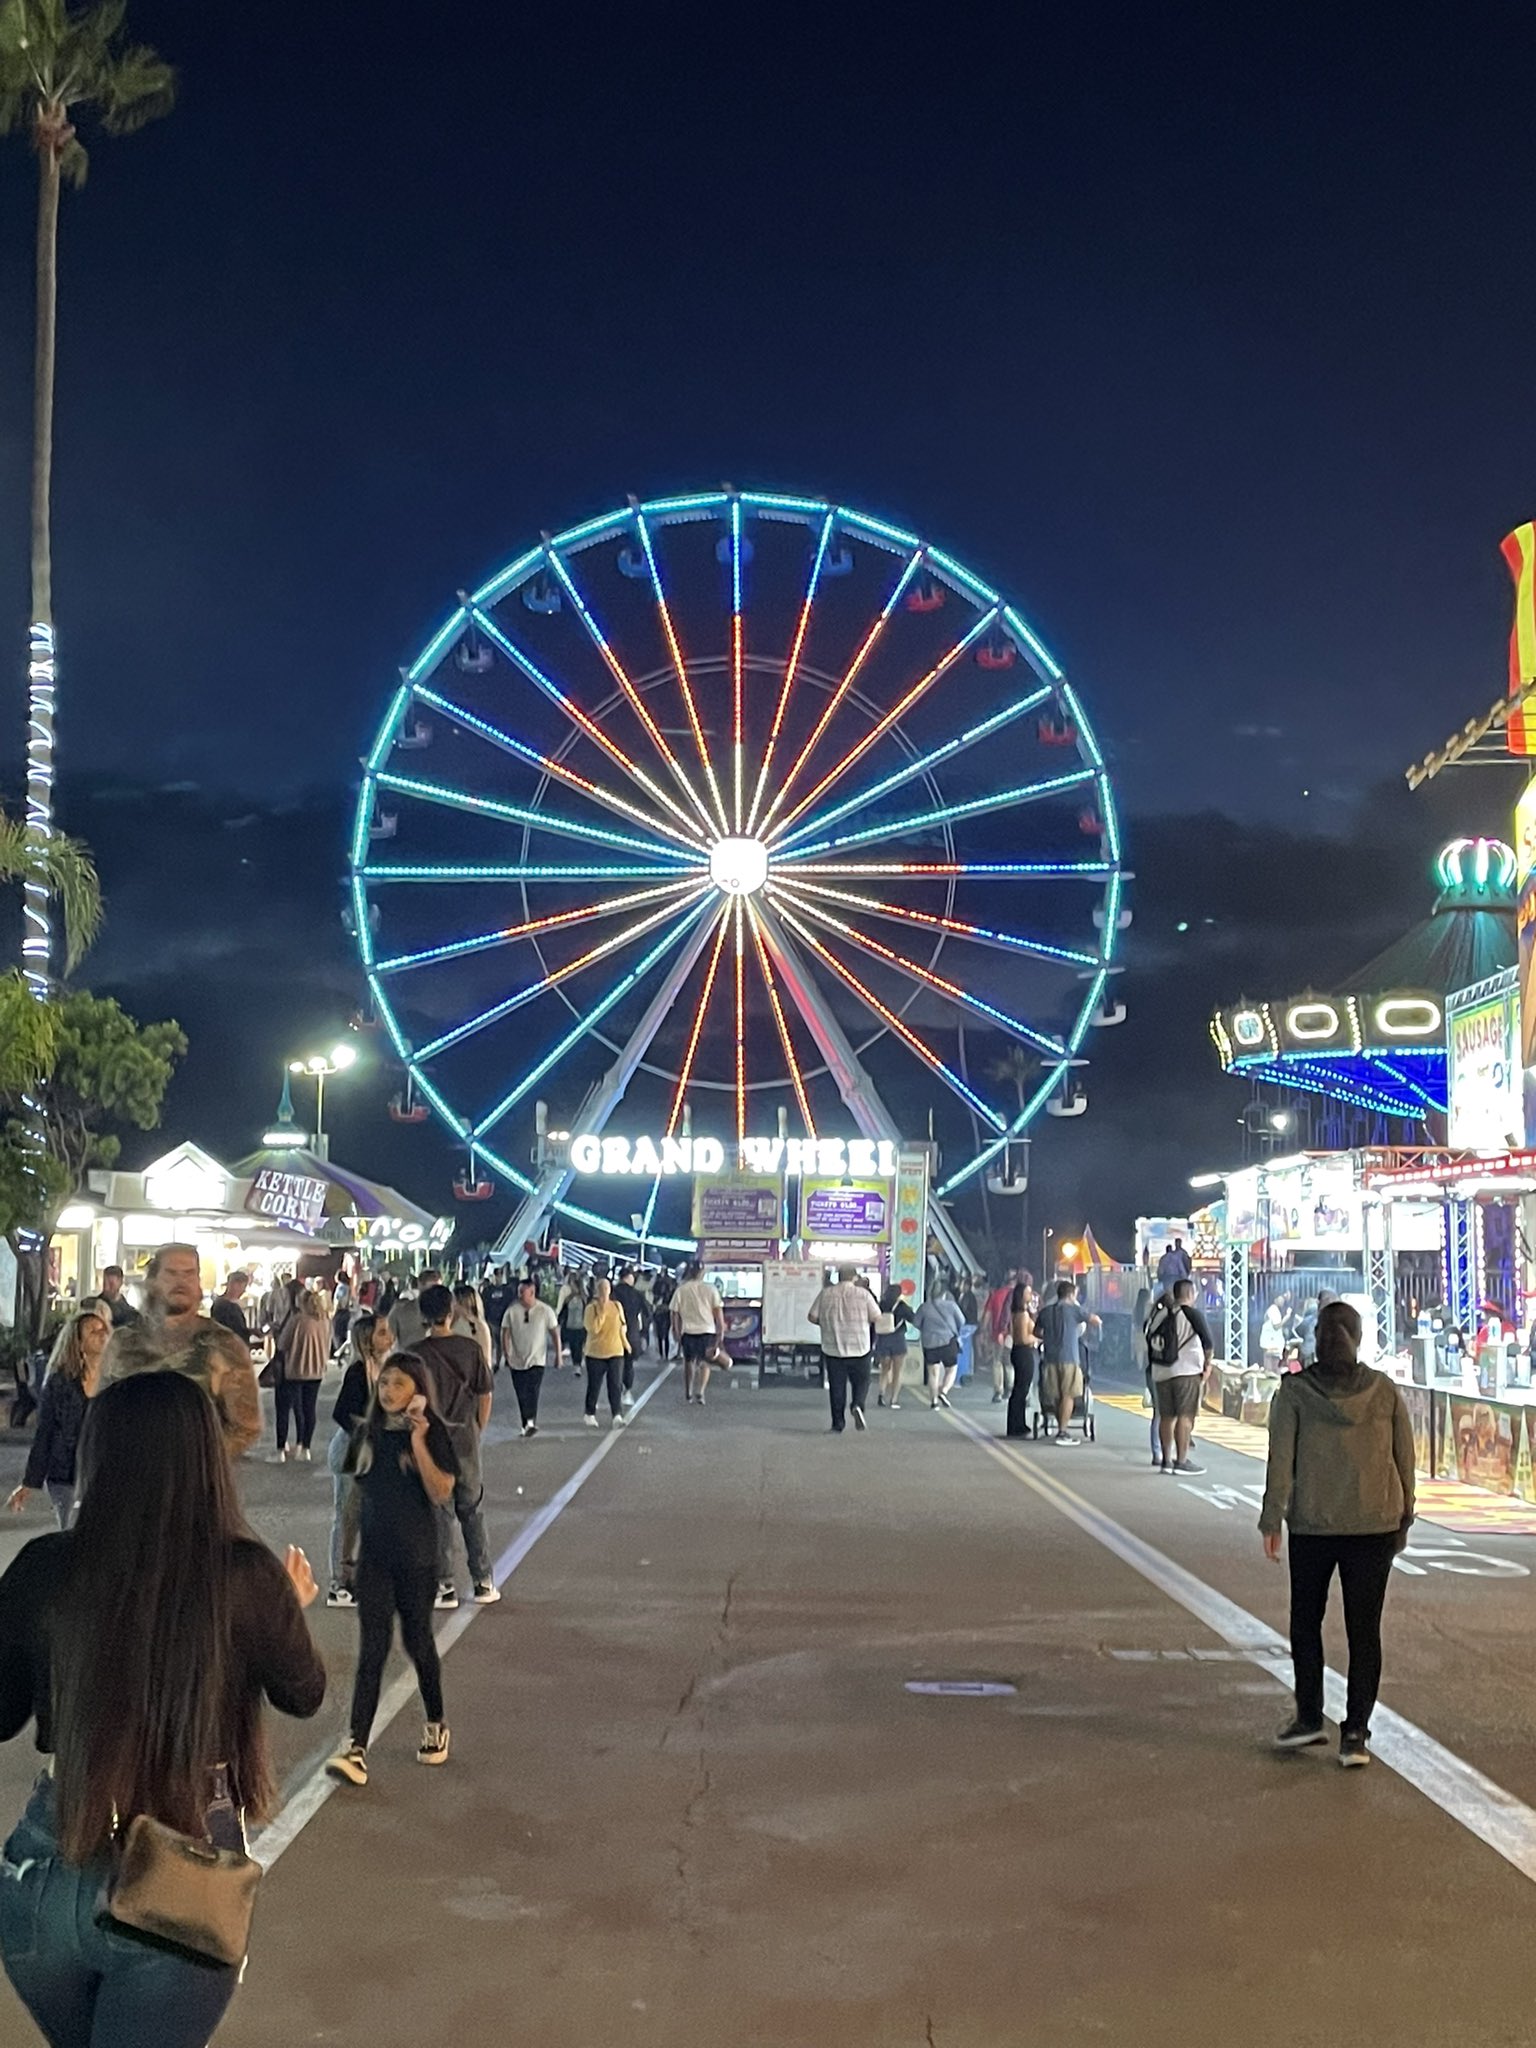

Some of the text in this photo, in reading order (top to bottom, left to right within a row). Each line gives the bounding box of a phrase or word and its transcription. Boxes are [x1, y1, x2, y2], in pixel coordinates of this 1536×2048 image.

[1456, 1013, 1503, 1063] SAUSAGE
[571, 1134, 896, 1176] GRAND WHEEL
[255, 1170, 326, 1203] KETTLE
[260, 1192, 310, 1222] CORN
